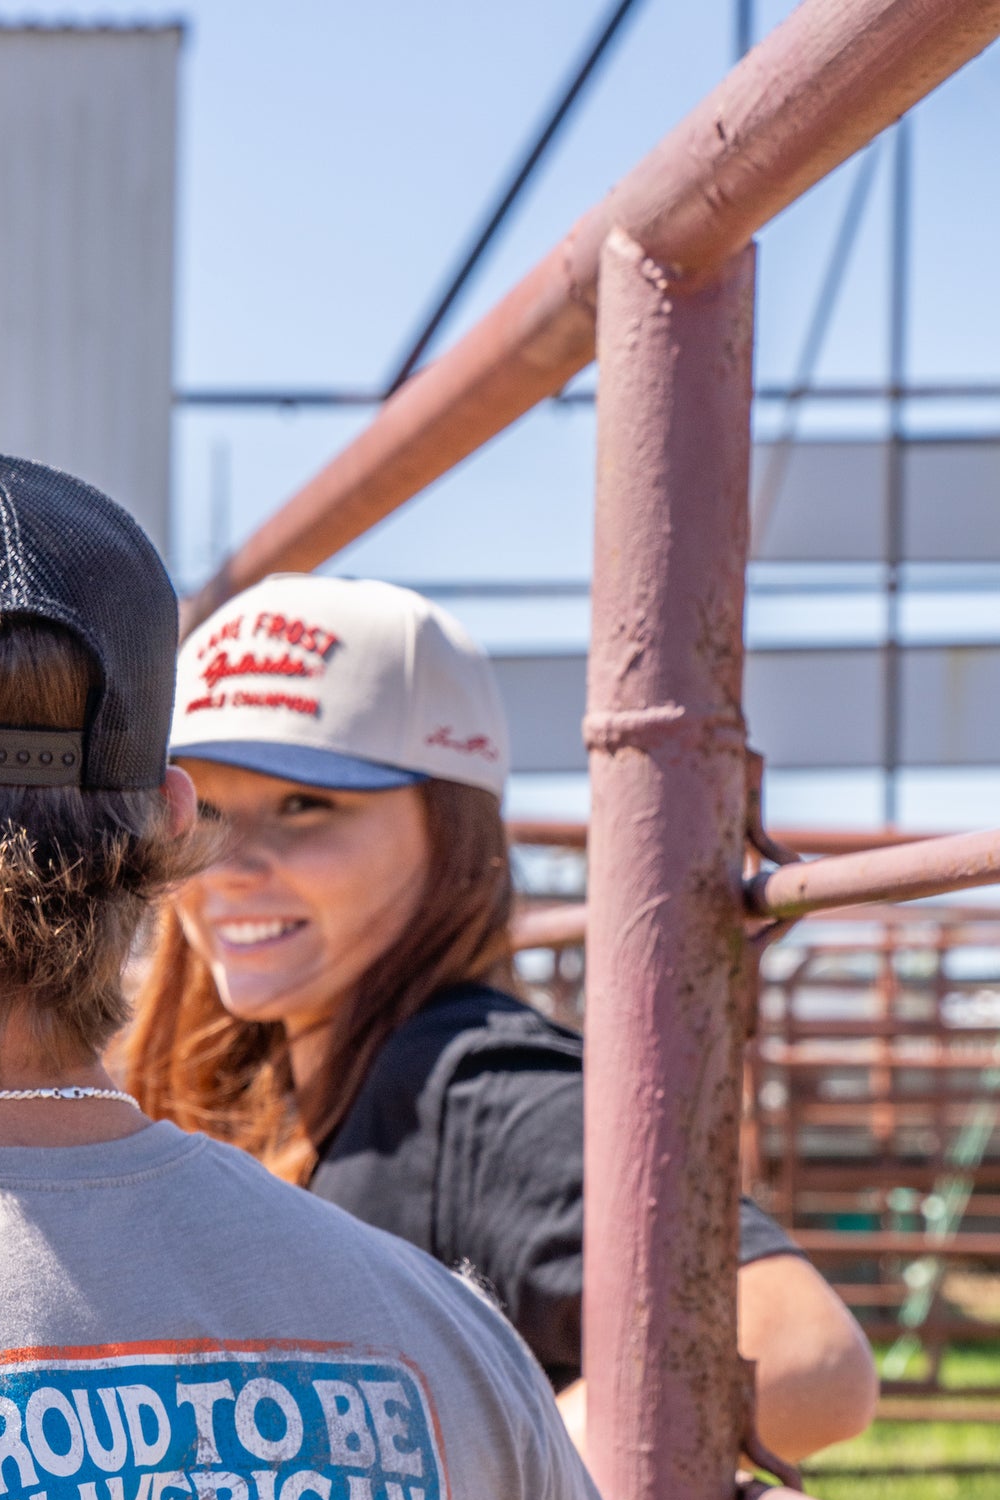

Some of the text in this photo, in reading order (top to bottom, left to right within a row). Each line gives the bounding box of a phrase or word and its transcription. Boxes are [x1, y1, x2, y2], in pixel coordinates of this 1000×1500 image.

[252, 612, 338, 658] FROST
[176, 1377, 304, 1465] TO
[311, 1378, 426, 1478] BE
